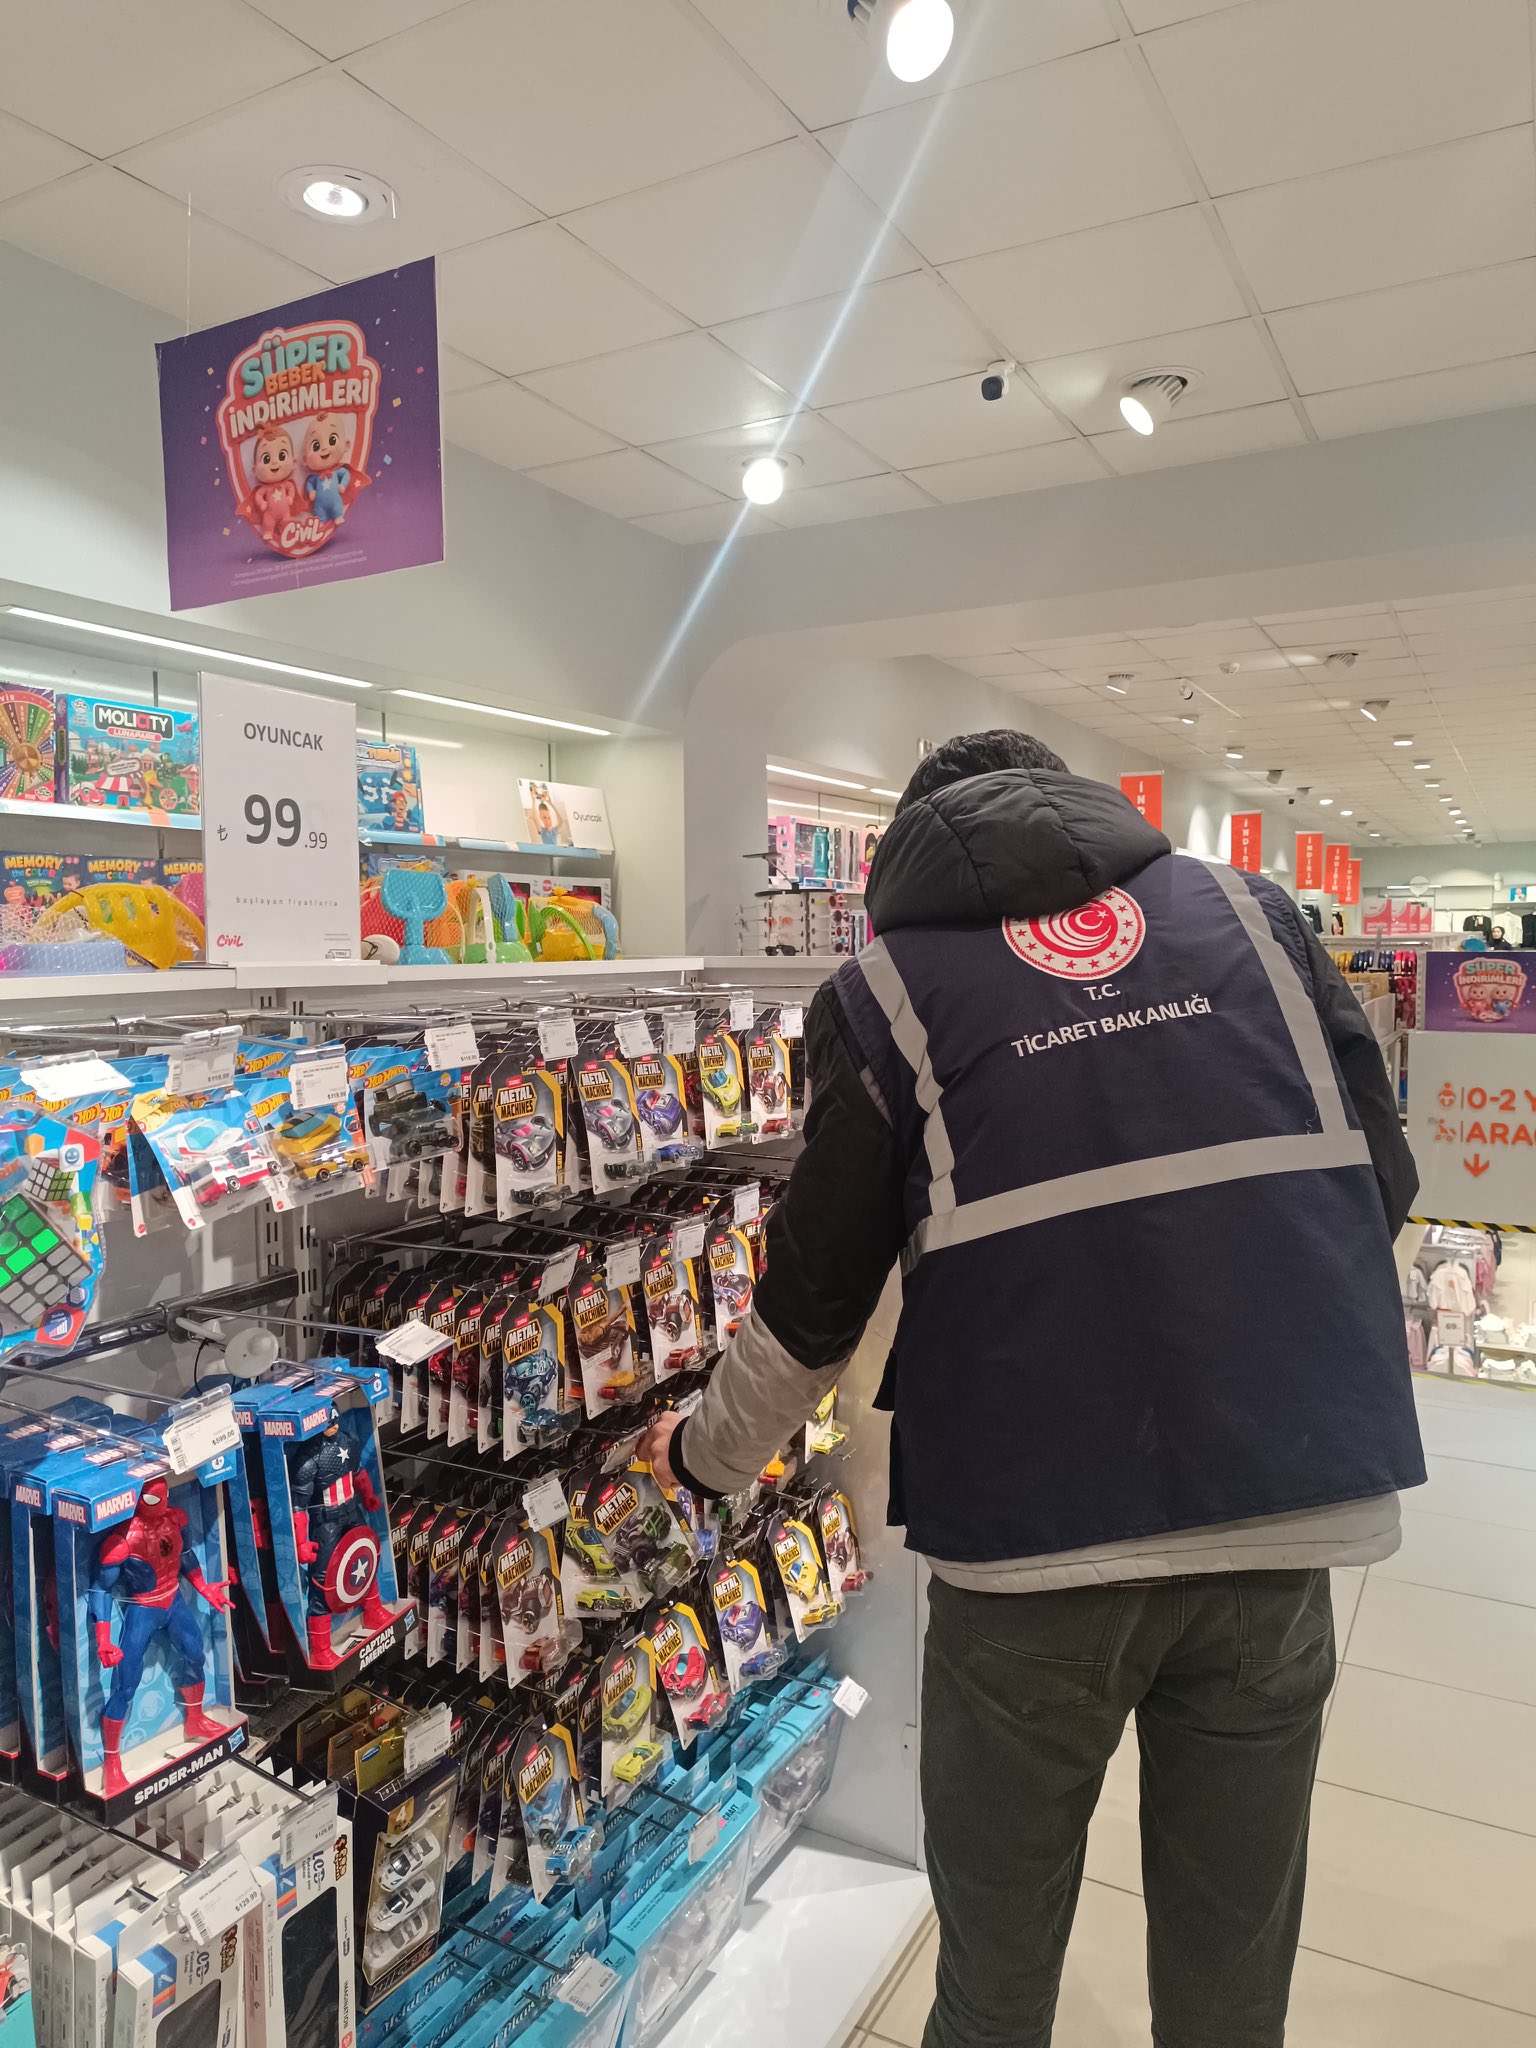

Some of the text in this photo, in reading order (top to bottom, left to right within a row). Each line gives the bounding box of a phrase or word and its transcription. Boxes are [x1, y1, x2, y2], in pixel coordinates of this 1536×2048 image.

[241, 333, 352, 398] SÜPER
[265, 360, 327, 396] BEBEK
[229, 370, 370, 438] İNDİRİMLERİ
[243, 721, 324, 752] OYUNCAK
[4, 855, 63, 870] MEMORY
[88, 860, 142, 874] MEMORY
[1083, 983, 1121, 1001] T.C.
[1010, 993, 1213, 1058] TİCARET BAKANLIĞI
[582, 1071, 608, 1086] METAL
[637, 1062, 661, 1075] METAL
[500, 1085, 532, 1105] METAL
[584, 1084, 611, 1099] MACHINES
[1467, 1087, 1516, 1112] 0-2
[103, 1102, 128, 1122] HOT
[252, 1101, 270, 1118] HOT
[501, 1101, 534, 1118] MACHINES
[1466, 1121, 1536, 1147] ARA
[712, 1243, 732, 1256] METAL
[647, 1265, 672, 1283] METAL
[649, 1276, 673, 1296] MACHINES
[577, 1291, 604, 1314] METAL
[580, 1304, 607, 1324] MACHINES
[509, 1323, 538, 1347] METAL
[509, 1336, 539, 1358] MACHINES
[235, 1411, 253, 1425] RVEL
[264, 1421, 294, 1436] MARVEL
[303, 1408, 328, 1432] MARVEL
[15, 1485, 42, 1507] MARVEL
[96, 1490, 135, 1521] MARVEL
[596, 1487, 632, 1523] METAL
[58, 1501, 86, 1523] MARVEL
[603, 1496, 637, 1533] MACHINES
[823, 1508, 839, 1525] METAL
[776, 1536, 797, 1556] METAL
[502, 1542, 530, 1573] METAL
[781, 1548, 800, 1567] MACHINES
[503, 1555, 532, 1585] MACHINES
[716, 1575, 739, 1597] METAL
[718, 1588, 742, 1610] MACHINES
[359, 1625, 394, 1659] CAPTAIN
[653, 1623, 677, 1652] METAL
[360, 1635, 396, 1671] AMERICA
[607, 1659, 633, 1692] METAL
[134, 1745, 224, 1806] SPIDER-MAN
[521, 1749, 549, 1788] METAL
[525, 1766, 551, 1802] MACHINES
[384, 1990, 421, 2032] Metal
